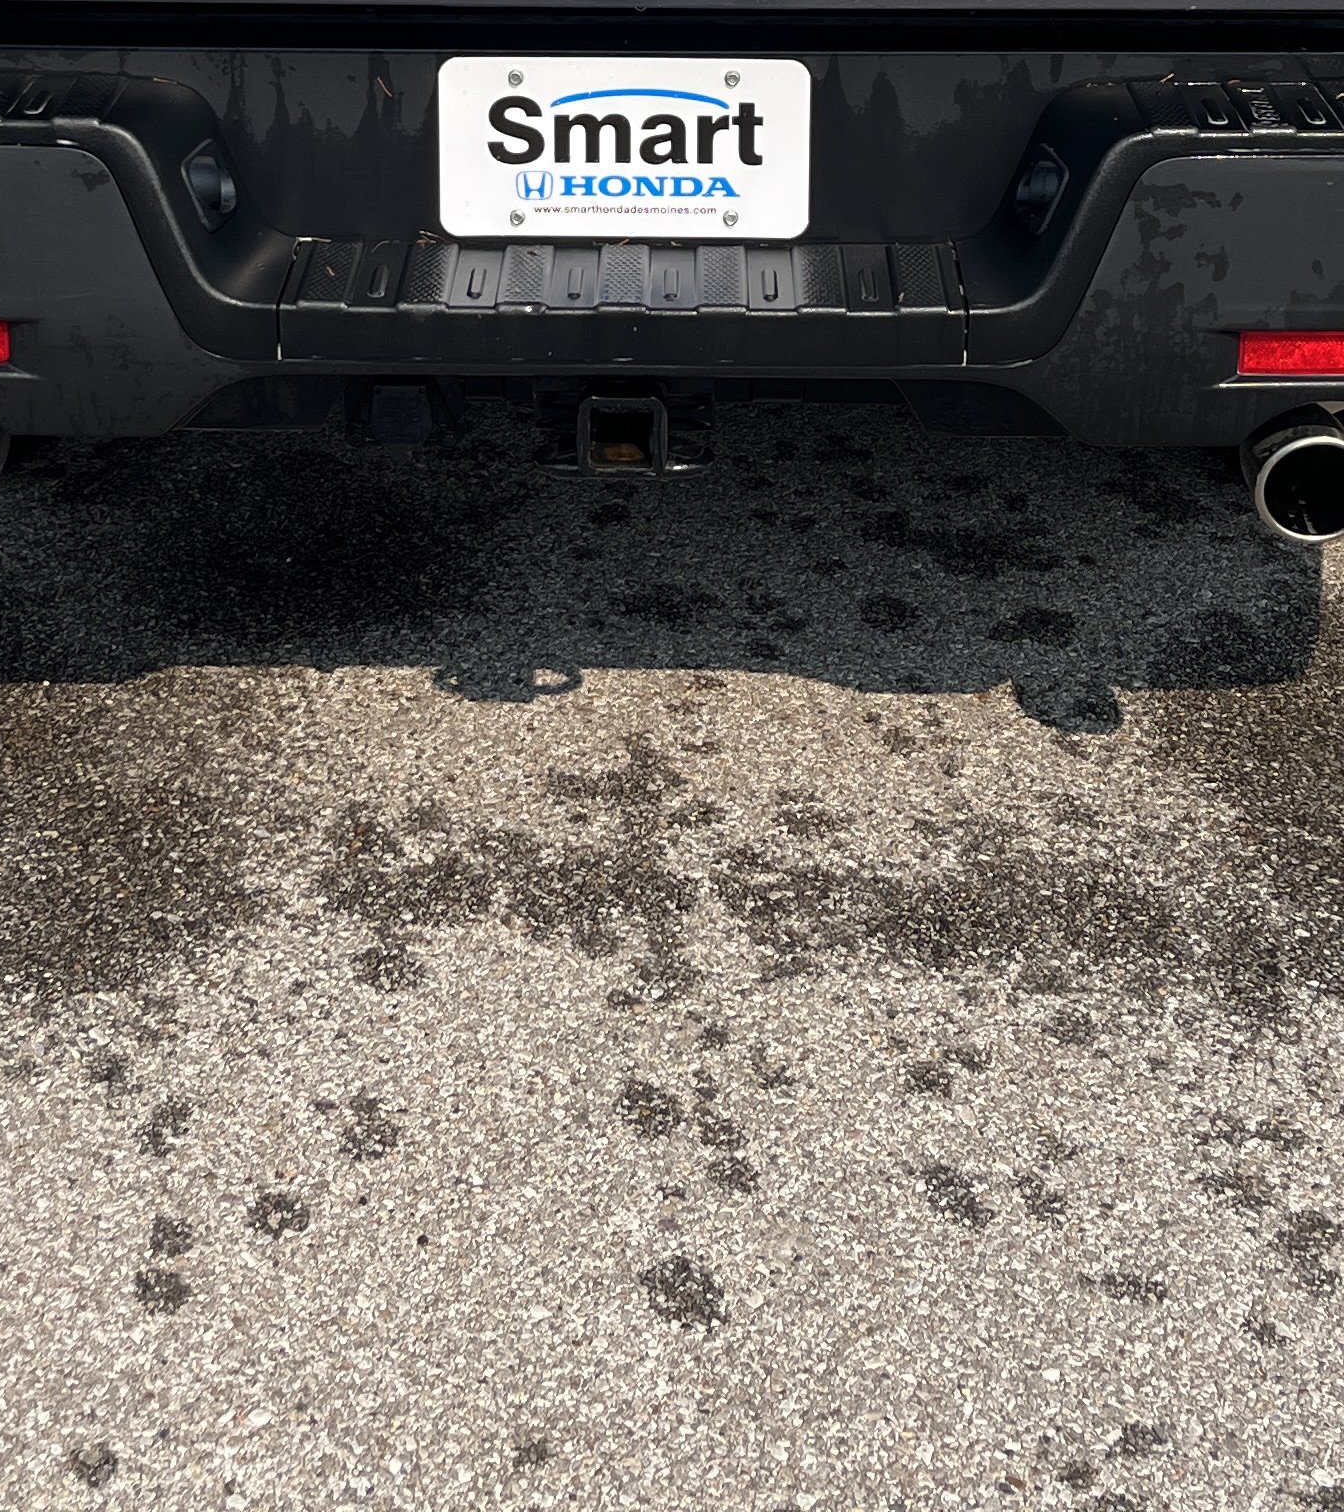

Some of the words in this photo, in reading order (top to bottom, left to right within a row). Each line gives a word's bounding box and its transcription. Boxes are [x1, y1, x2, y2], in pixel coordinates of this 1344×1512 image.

[487, 95, 764, 166] Smart
[559, 175, 741, 198] HONDA
[533, 204, 717, 215] www.smarthondadesmoines.com
